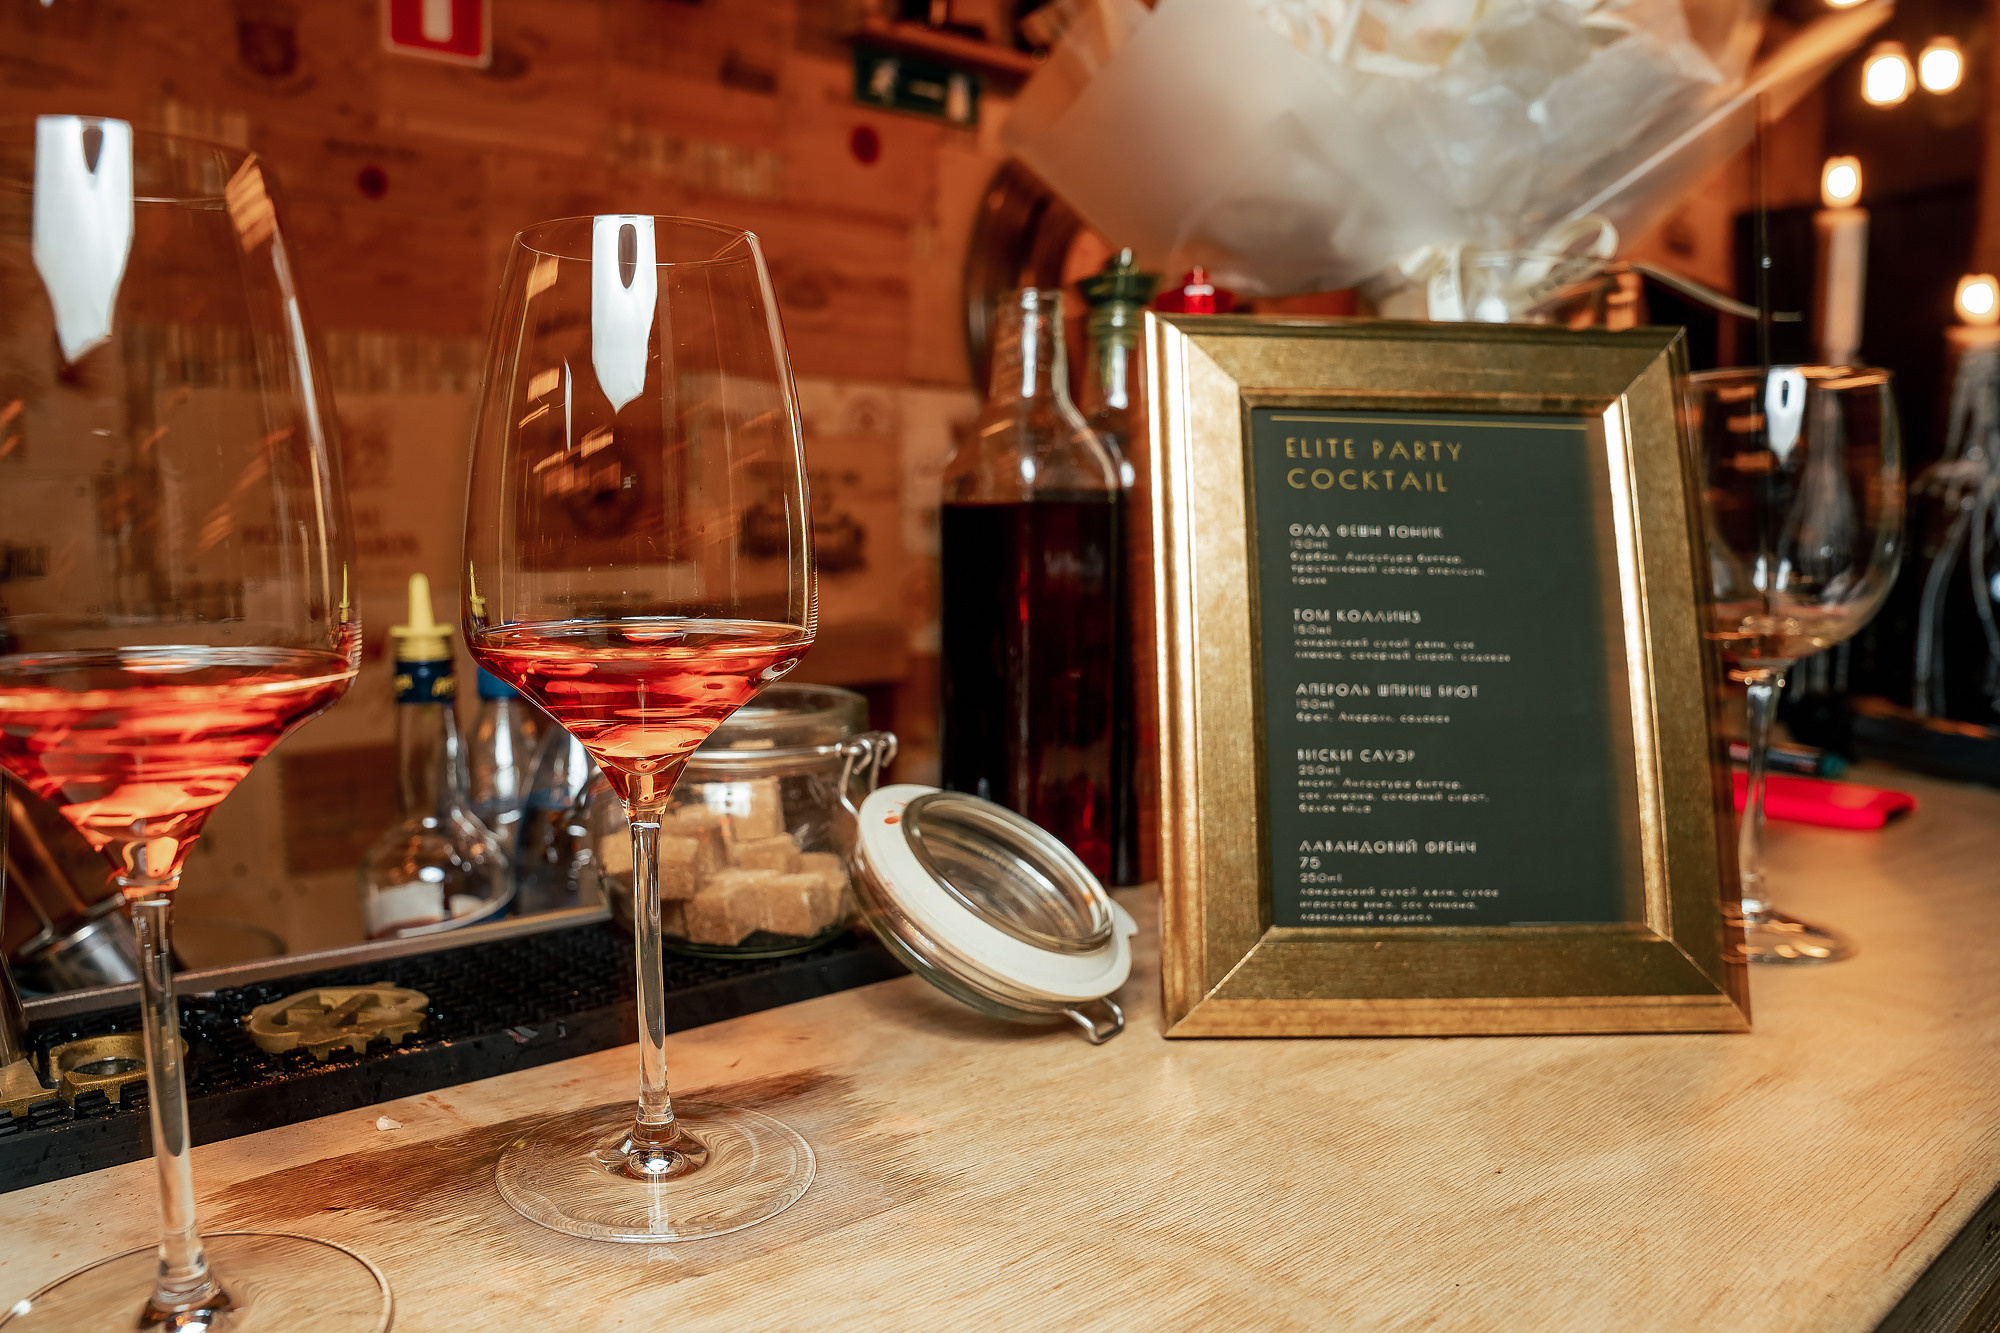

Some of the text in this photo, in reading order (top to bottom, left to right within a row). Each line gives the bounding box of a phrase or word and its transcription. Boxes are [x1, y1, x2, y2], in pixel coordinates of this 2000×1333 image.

[1286, 437, 1462, 462] ELITE PARTY
[1287, 468, 1448, 492] COCKTAIL
[1388, 524, 1444, 538] ТОНИК
[1293, 608, 1421, 624] ТОМ КОЛЛИНЗ
[1296, 683, 1478, 698] АПЕРОЛЬ ШПРИЦ БРЮТ
[1297, 748, 1415, 763] ВИСКИ САУЭР
[1299, 839, 1476, 854] ЛАВАНДОВЫЙ ФРЕНЧ
[1299, 856, 1321, 869] 75
